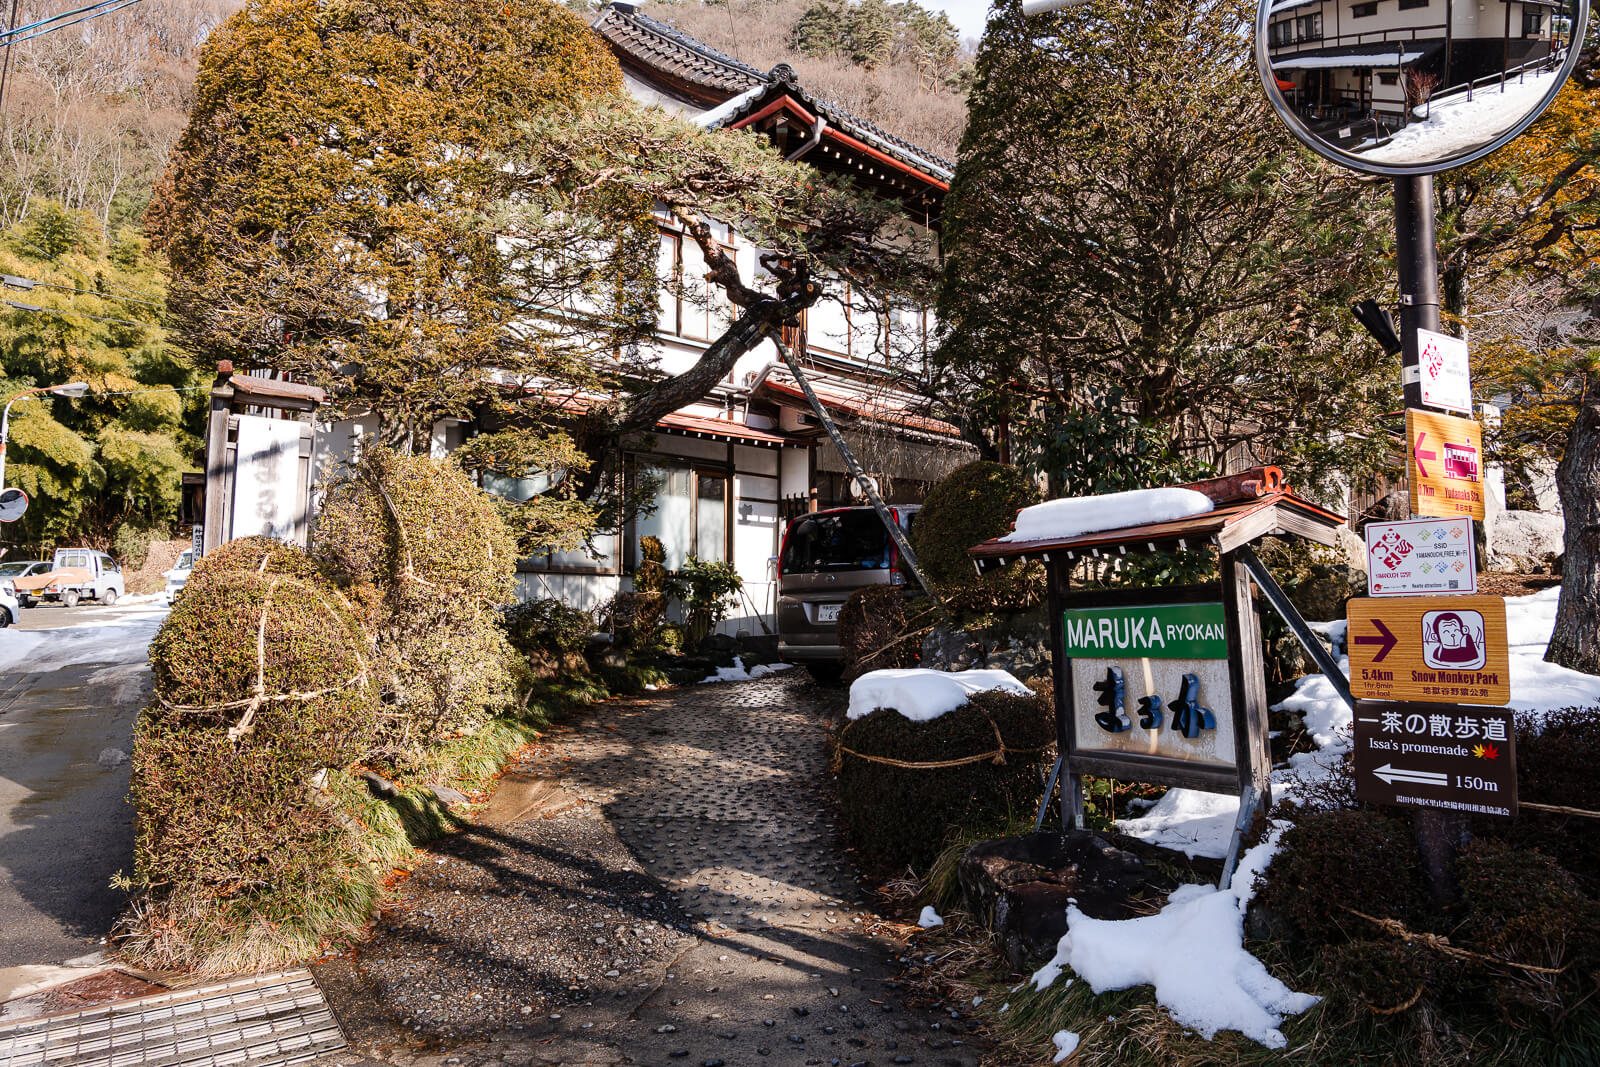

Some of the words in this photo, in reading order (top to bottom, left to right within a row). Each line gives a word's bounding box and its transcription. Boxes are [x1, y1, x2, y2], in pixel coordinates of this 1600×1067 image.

[1445, 487, 1470, 501] Yudanaka
[1067, 616, 1165, 649] MARUKA
[1166, 623, 1225, 641] RYOKAN
[1362, 668, 1394, 681] 5.4km
[1411, 670, 1437, 682] Snow
[1438, 671, 1474, 685] Monkey
[1476, 672, 1499, 685] Park
[1093, 665, 1216, 738] まるか
[1377, 690, 1391, 698] foot
[1358, 711, 1508, 741] 一茶の散歩道
[1369, 738, 1399, 750] Issa's
[1401, 741, 1469, 757] promenade
[1455, 776, 1499, 792] 150m
